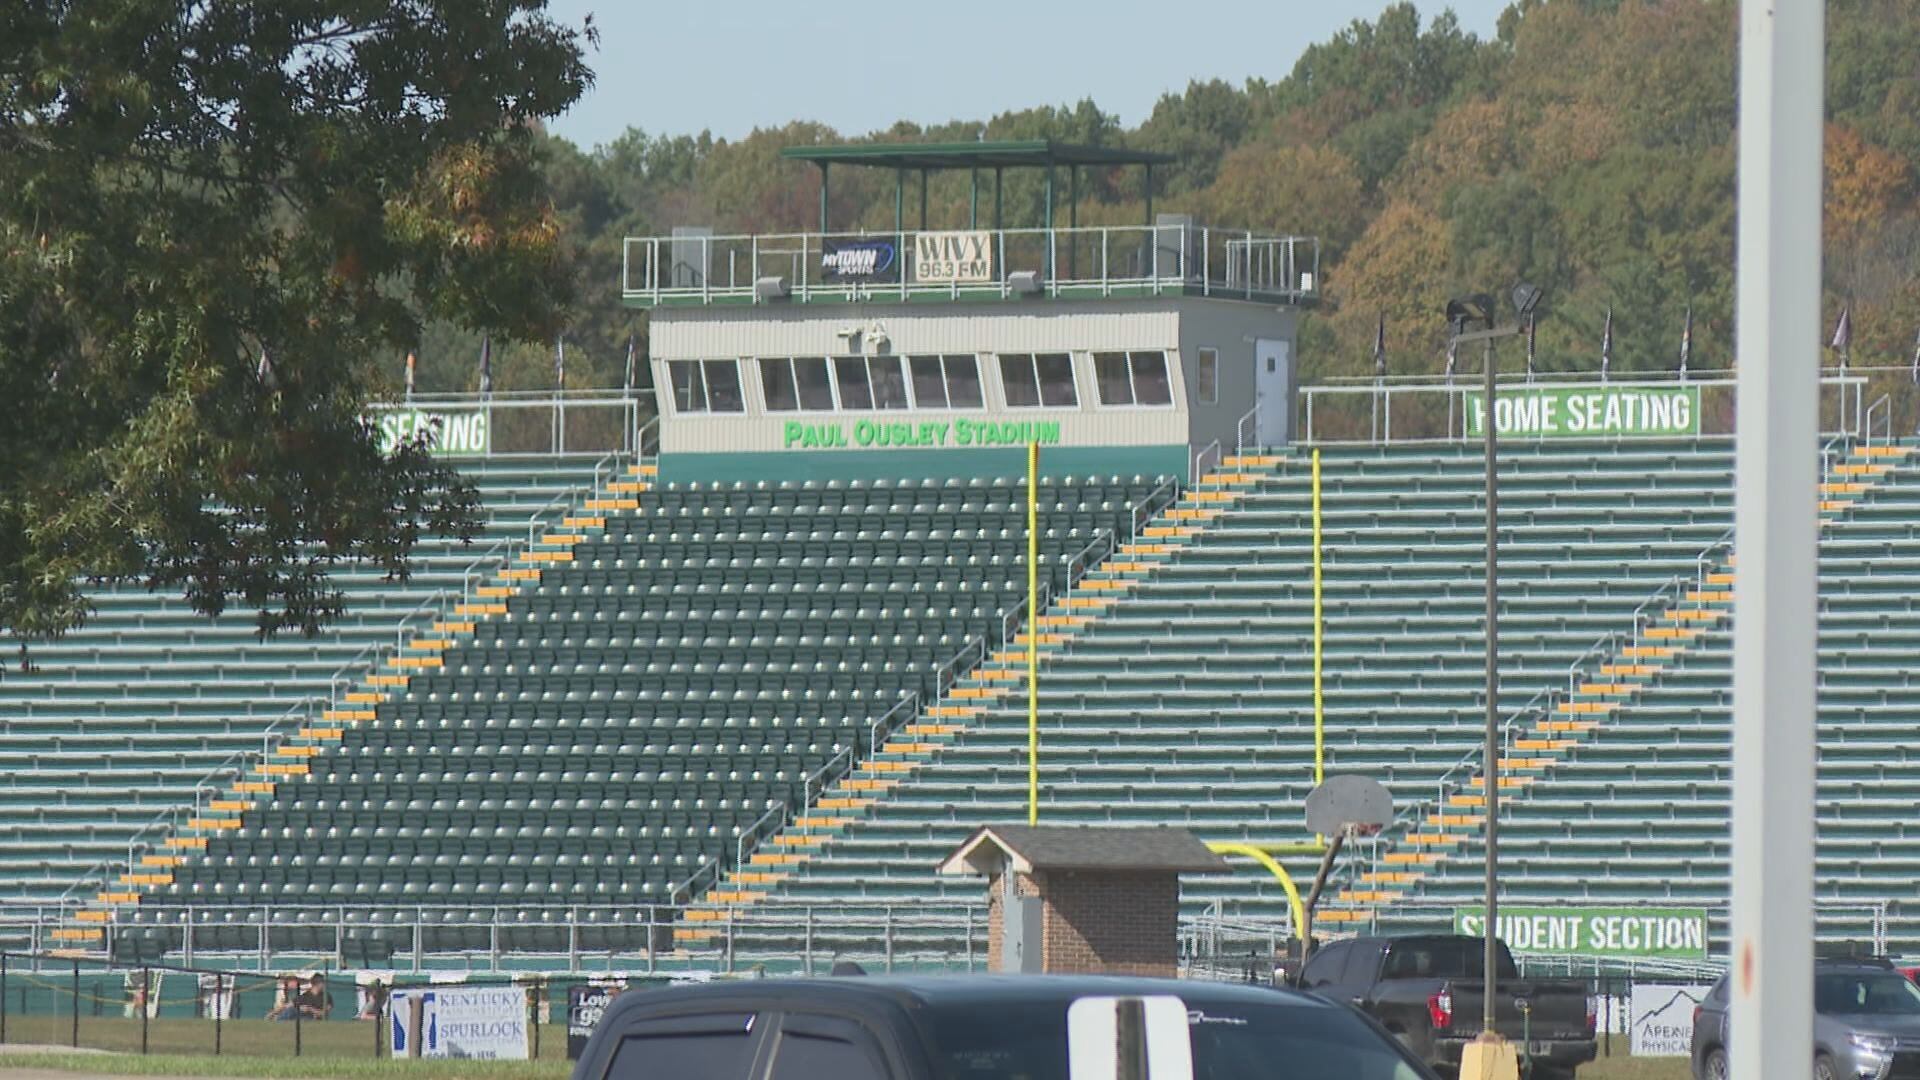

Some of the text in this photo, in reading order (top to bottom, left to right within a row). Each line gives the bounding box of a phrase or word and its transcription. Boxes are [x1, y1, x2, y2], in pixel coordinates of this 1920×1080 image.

[919, 236, 987, 261] WIVY
[919, 262, 987, 278] 96.3 FM
[1567, 394, 1690, 432] SEATING
[1590, 916, 1704, 950] SECTION
[440, 992, 522, 1006] KENTUCKY
[440, 1022, 523, 1039] SPURLOCK
